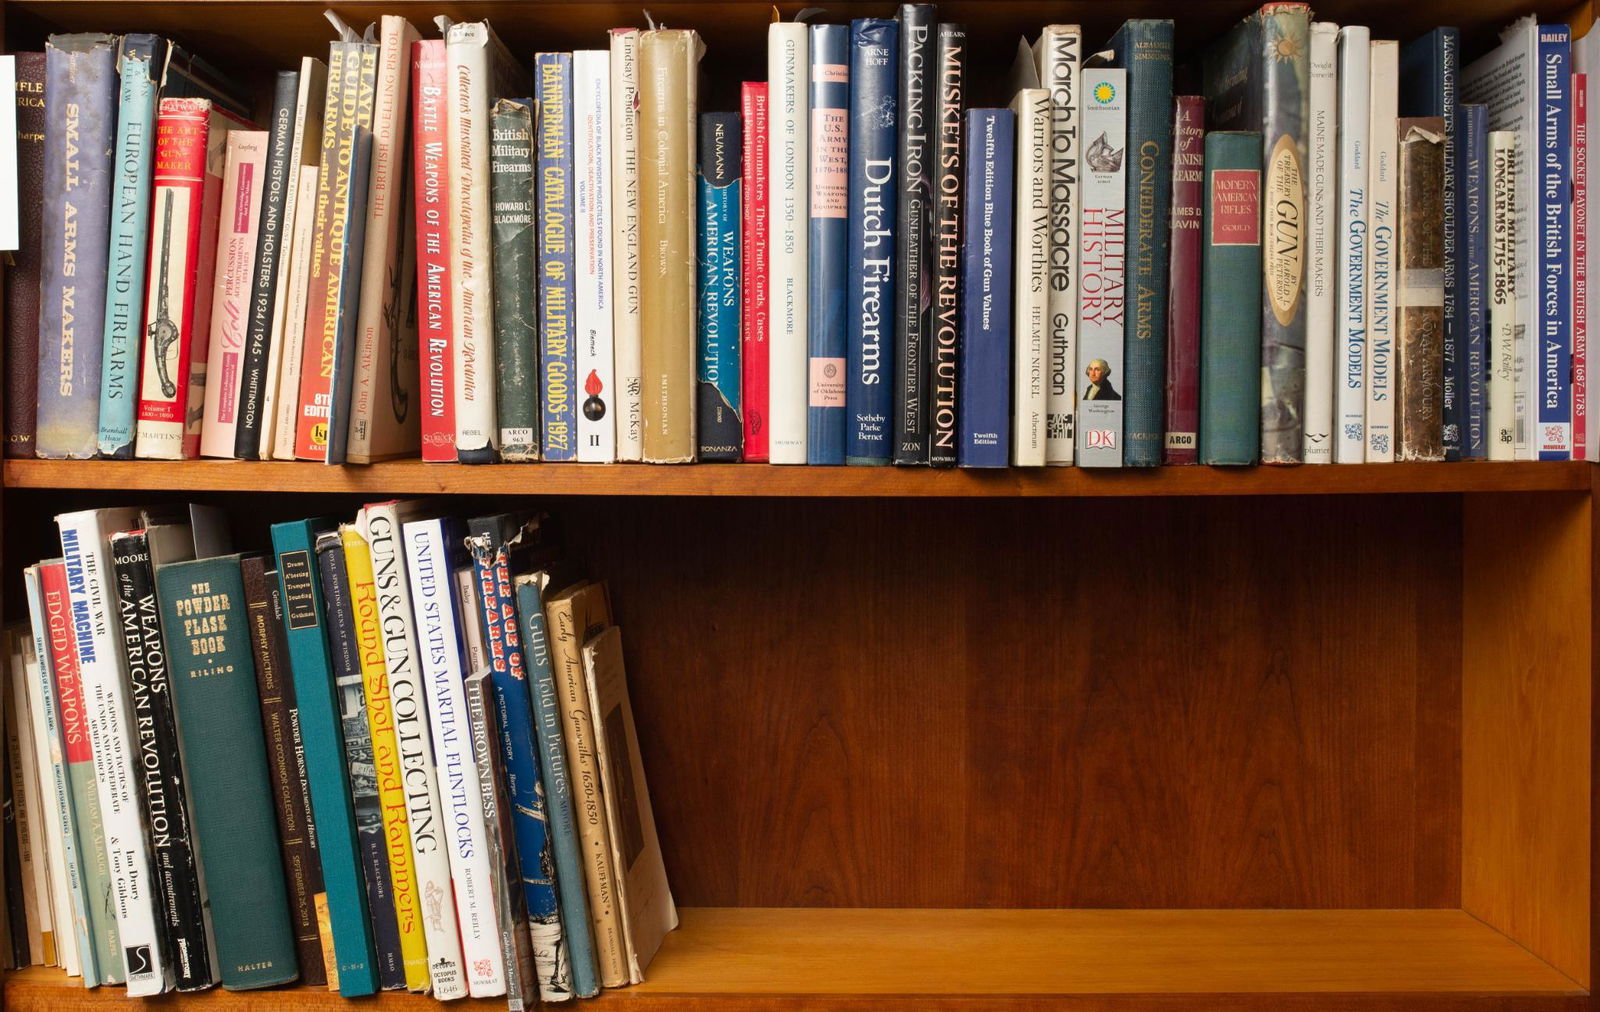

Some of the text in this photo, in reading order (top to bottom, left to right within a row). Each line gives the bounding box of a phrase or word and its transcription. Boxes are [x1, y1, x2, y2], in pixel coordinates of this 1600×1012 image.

[1541, 34, 1567, 42] BAILEY
[324, 49, 343, 149] FIREARMS
[423, 87, 441, 132] BATTLE
[542, 64, 564, 158] BANNERMAN
[785, 40, 794, 190] GUNMAKERS OF LONDON
[906, 24, 927, 193] PACKING IRON
[491, 145, 529, 157] Military
[493, 129, 529, 141] British
[626, 149, 636, 174] THE
[715, 124, 724, 179] NEUMANN
[1050, 38, 1076, 292] March To Massacre
[1444, 36, 1454, 287] MASSACHUSETTS MILITARY SHOULDER ARMS
[1577, 123, 1586, 144] THE
[425, 142, 442, 203] WEAPONS
[492, 161, 531, 173] Firearms
[626, 179, 636, 210] NEW
[1031, 98, 1049, 292] Warriors and Worthies
[1576, 147, 1586, 185] SOCKET
[321, 51, 359, 378] GUIDE TO ANTIQUE AMERICAN
[426, 210, 438, 226] OF
[544, 167, 566, 253] CATALOGUE
[982, 115, 995, 330] Twelfth Edition Blue Book of Gun Values
[1136, 141, 1159, 339] CONFEDERATE ARMS
[1545, 54, 1562, 408] Small Arms of the British Forces in America
[1576, 189, 1585, 235] BAYONET
[59, 103, 79, 396] SMALL ARMS MAKERS
[108, 122, 142, 399] EUROPEAN HAND FIREARMS
[246, 108, 288, 429] GERMAN PISTOLS AND HOLSTERS 1934/1945 WHITTINGTON
[427, 233, 440, 254] THE
[545, 261, 566, 281] OF
[627, 215, 637, 280] ENGLAND
[862, 157, 892, 385] Dutch Firearms
[935, 46, 962, 448] MUSKETS OF THE REVOLUTION
[1082, 208, 1103, 327] HISTORY
[1103, 208, 1125, 327] MILITARY
[1576, 240, 1585, 251] IN
[1576, 255, 1585, 277] THE
[427, 263, 445, 329] AMERICAN
[628, 286, 638, 315] GUN
[1348, 188, 1366, 388] The GOVERNMENT MODELS
[1576, 280, 1585, 324] BRITISH
[546, 286, 567, 357] MILITARY
[1576, 327, 1585, 358] ARMY
[429, 338, 447, 417] REVOLUTION
[1052, 313, 1068, 396] Guthman
[856, 414, 885, 422] Sotheby
[1444, 376, 1454, 410] Moller
[858, 432, 883, 440] Bernet
[860, 423, 881, 431] Parke
[1088, 431, 1115, 447] DK
[1169, 436, 1192, 444] ARCO
[114, 553, 149, 565] MOORE
[191, 582, 210, 595] THE
[328, 549, 336, 571] ROYAL
[332, 574, 342, 606] SPORTING
[62, 529, 96, 664] MILITARY MACHINE
[85, 552, 105, 636] THE CIVIL WAR
[176, 594, 231, 617] POWDER
[184, 615, 227, 636] FLASK
[138, 594, 167, 693] WEAPONS
[191, 635, 225, 656] BOOK
[256, 615, 274, 690] MORPHY AUCTIONS
[340, 631, 347, 639] AT
[341, 642, 352, 672] WINDSOR
[47, 591, 82, 744] EDGED WEAPONS
[368, 516, 438, 854] GUNS & GUN COLLECTING
[414, 531, 474, 859] UNITED STATES MARTIAL FLINTLOCKS
[120, 574, 171, 848] of the AMERICAN REVOLUTION
[529, 613, 568, 793] Guns Told in Pictures
[468, 683, 495, 818] THE BROWN BESS
[111, 849, 122, 874] Tony
[117, 878, 128, 919] Gibbons
[125, 850, 139, 901] Ian Drury
